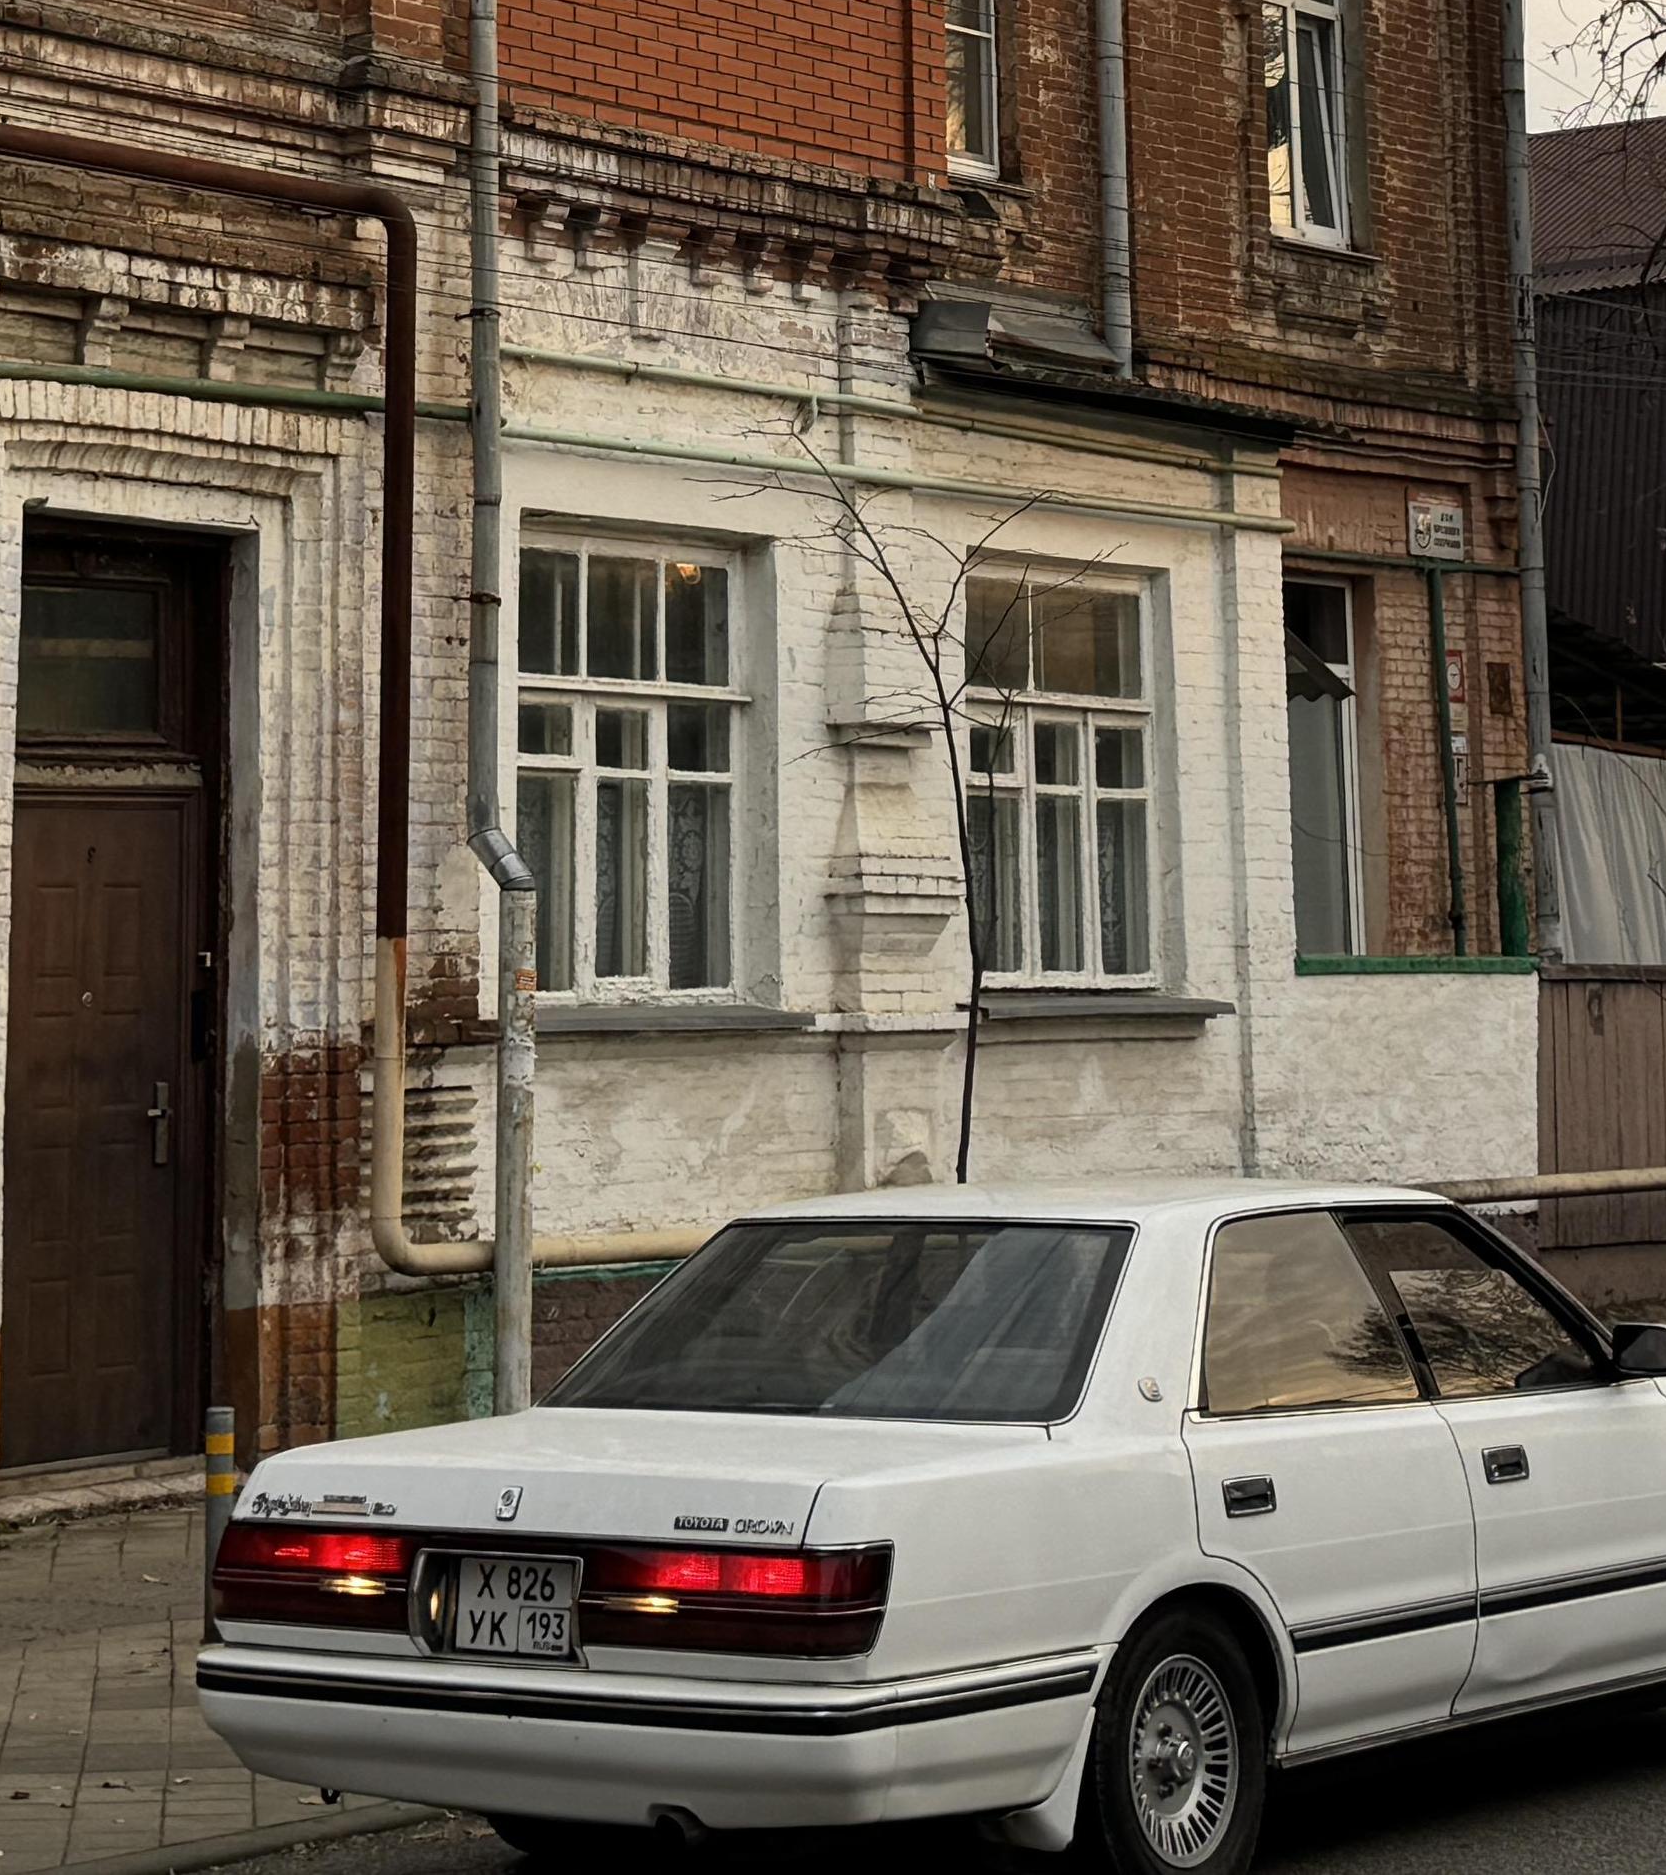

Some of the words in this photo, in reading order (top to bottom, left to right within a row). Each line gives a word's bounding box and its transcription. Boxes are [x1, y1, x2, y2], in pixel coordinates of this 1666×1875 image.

[676, 1516, 726, 1531] TOYOTA
[734, 1519, 795, 1535] CROWN
[507, 1566, 555, 1602] 826
[527, 1612, 565, 1640] 193
